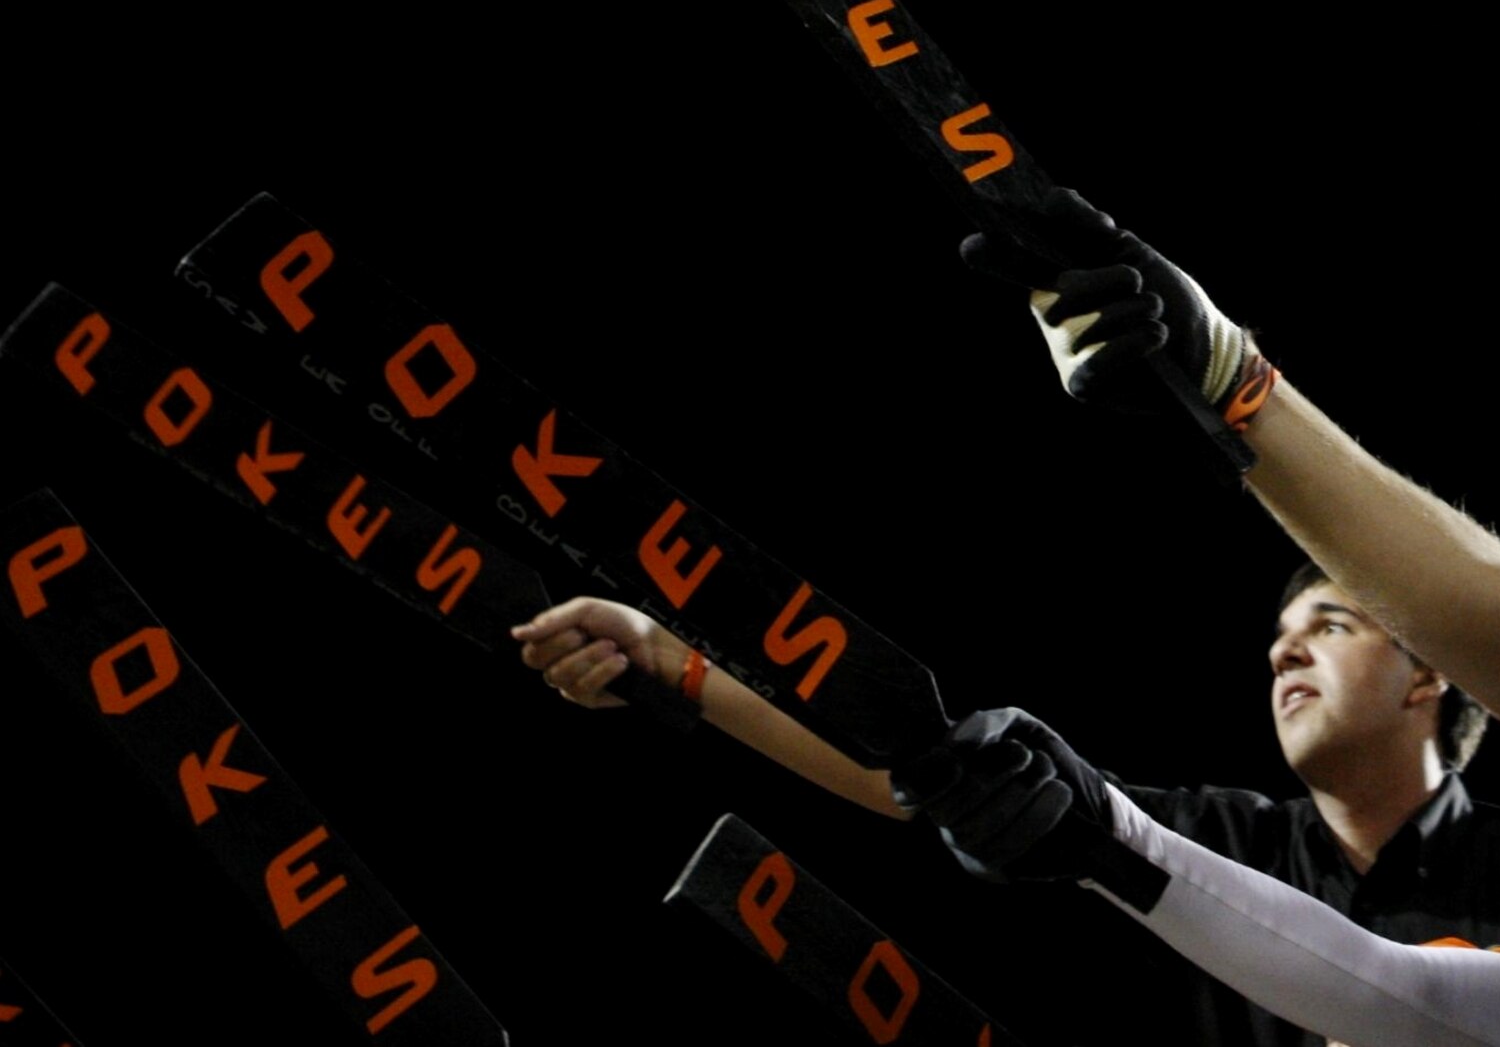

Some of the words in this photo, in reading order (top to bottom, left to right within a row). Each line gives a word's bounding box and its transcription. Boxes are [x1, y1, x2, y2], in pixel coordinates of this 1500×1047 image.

[53, 311, 483, 616] POKES
[258, 229, 849, 702] POKES
[494, 492, 621, 591] BEAT
[6, 525, 439, 1035] POKES
